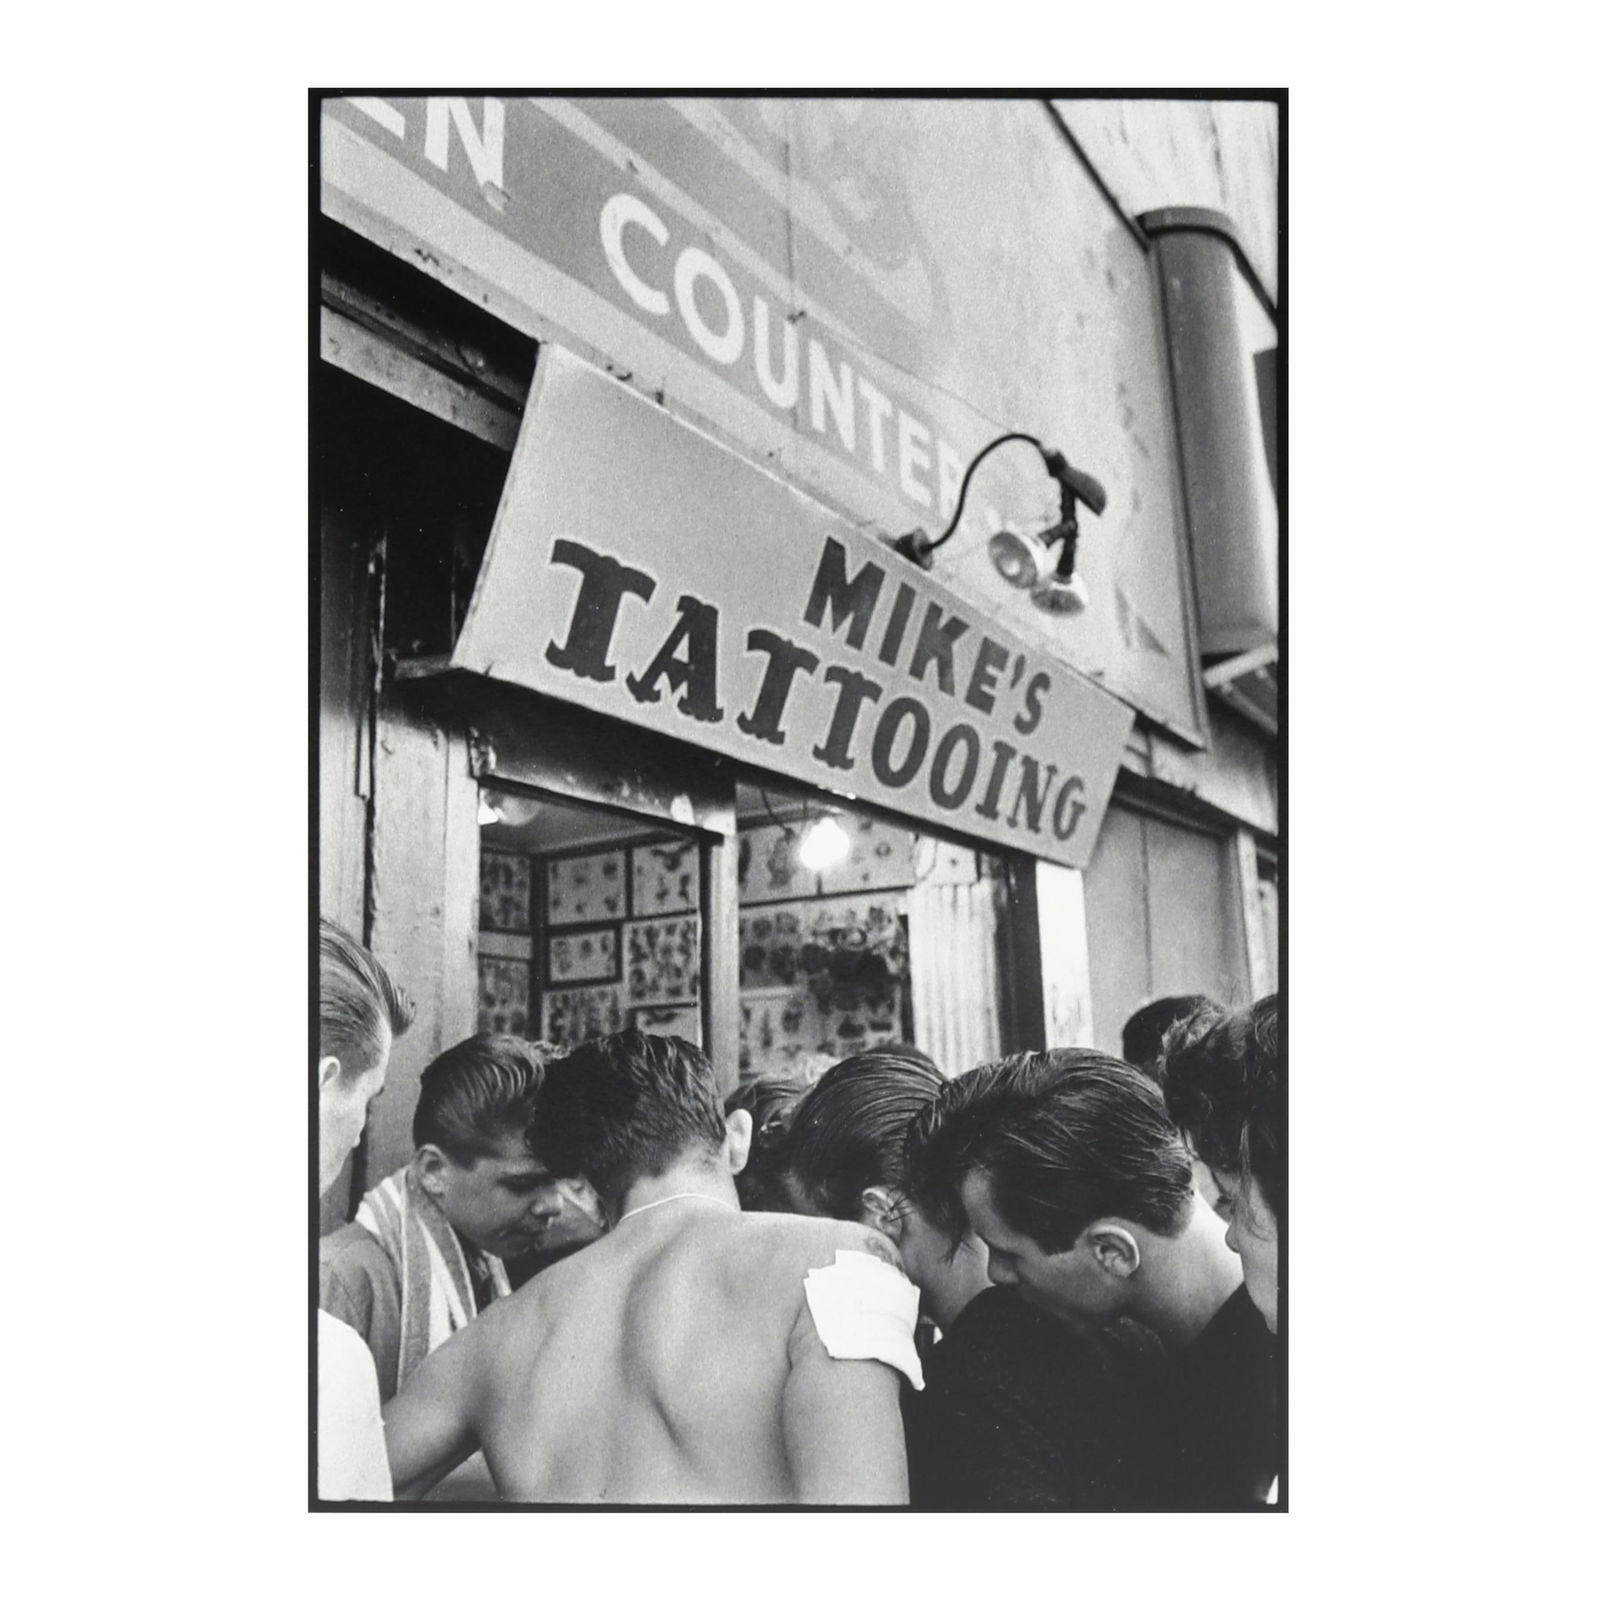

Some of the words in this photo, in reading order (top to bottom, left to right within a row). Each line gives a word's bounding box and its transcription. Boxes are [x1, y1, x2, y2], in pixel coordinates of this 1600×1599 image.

[600, 193, 967, 526] COUNTER
[544, 539, 1086, 841] TATTOOING
[803, 536, 1051, 735] MIKE'S
